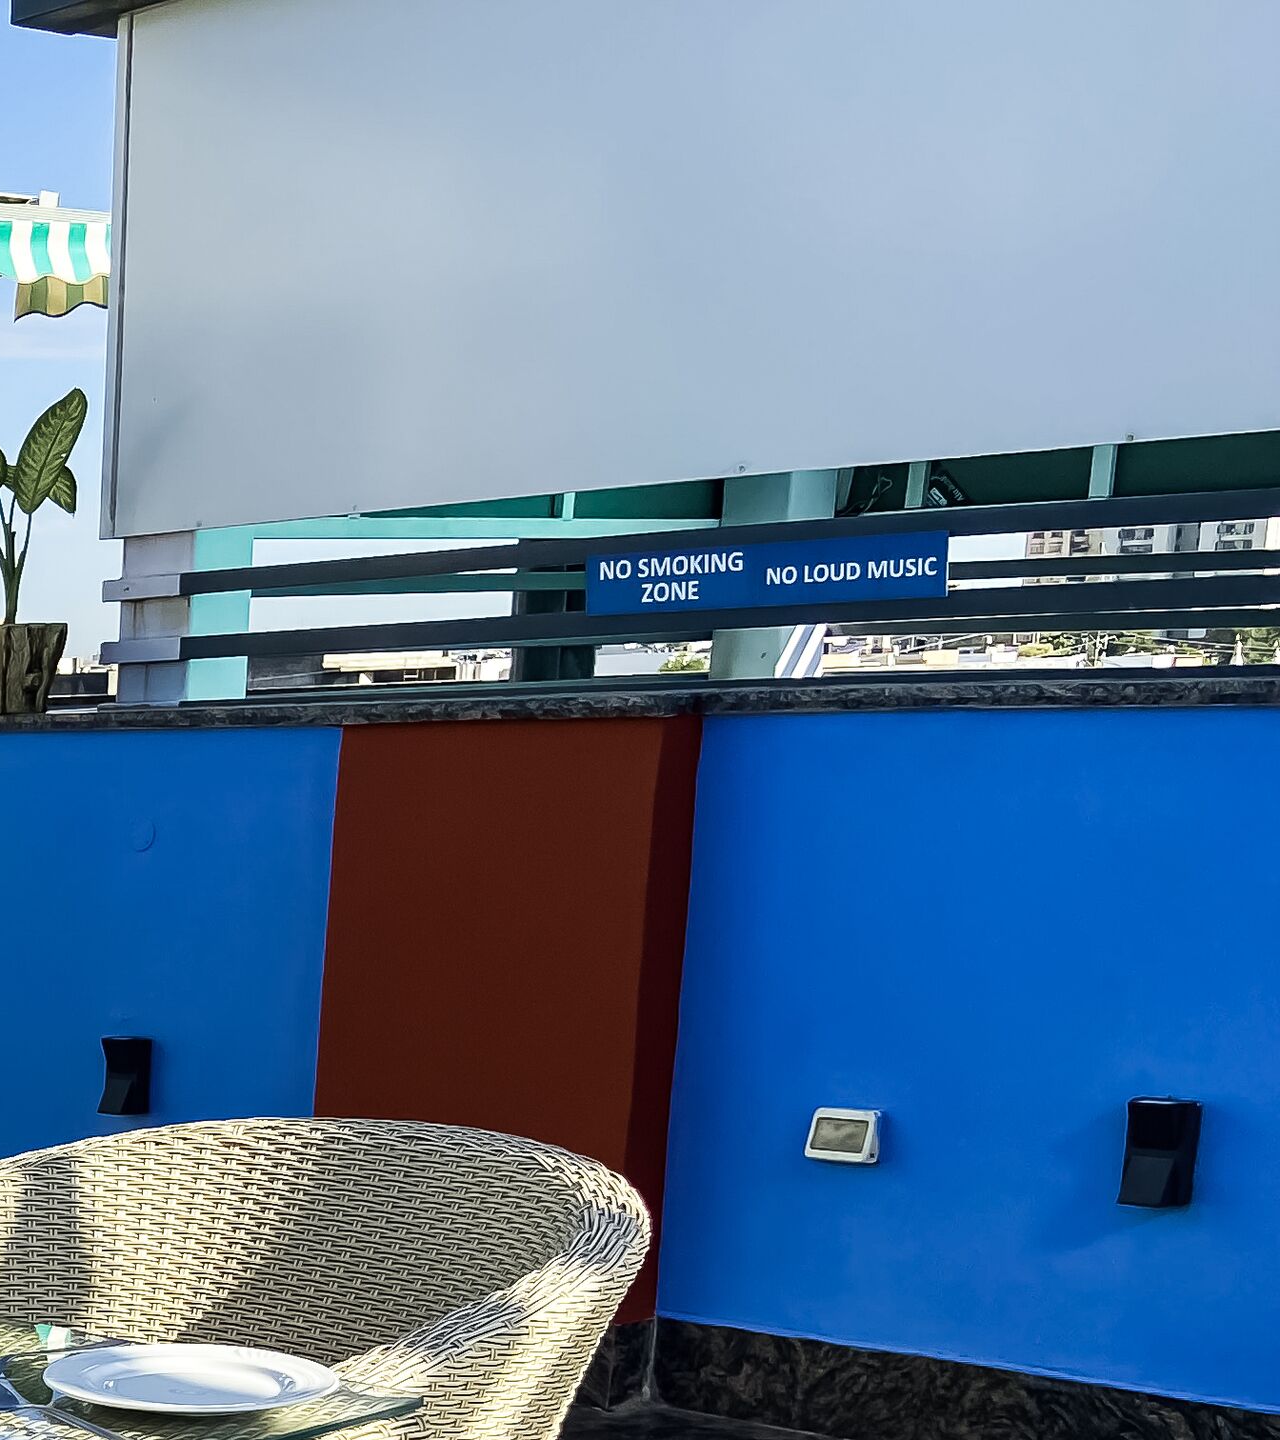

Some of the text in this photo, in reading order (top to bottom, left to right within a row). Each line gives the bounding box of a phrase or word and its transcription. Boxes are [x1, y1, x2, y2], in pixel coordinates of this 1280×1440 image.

[599, 551, 744, 581] NO SMOKING
[765, 556, 938, 586] NO LOUD MUSIC
[641, 580, 700, 603] ZONE
